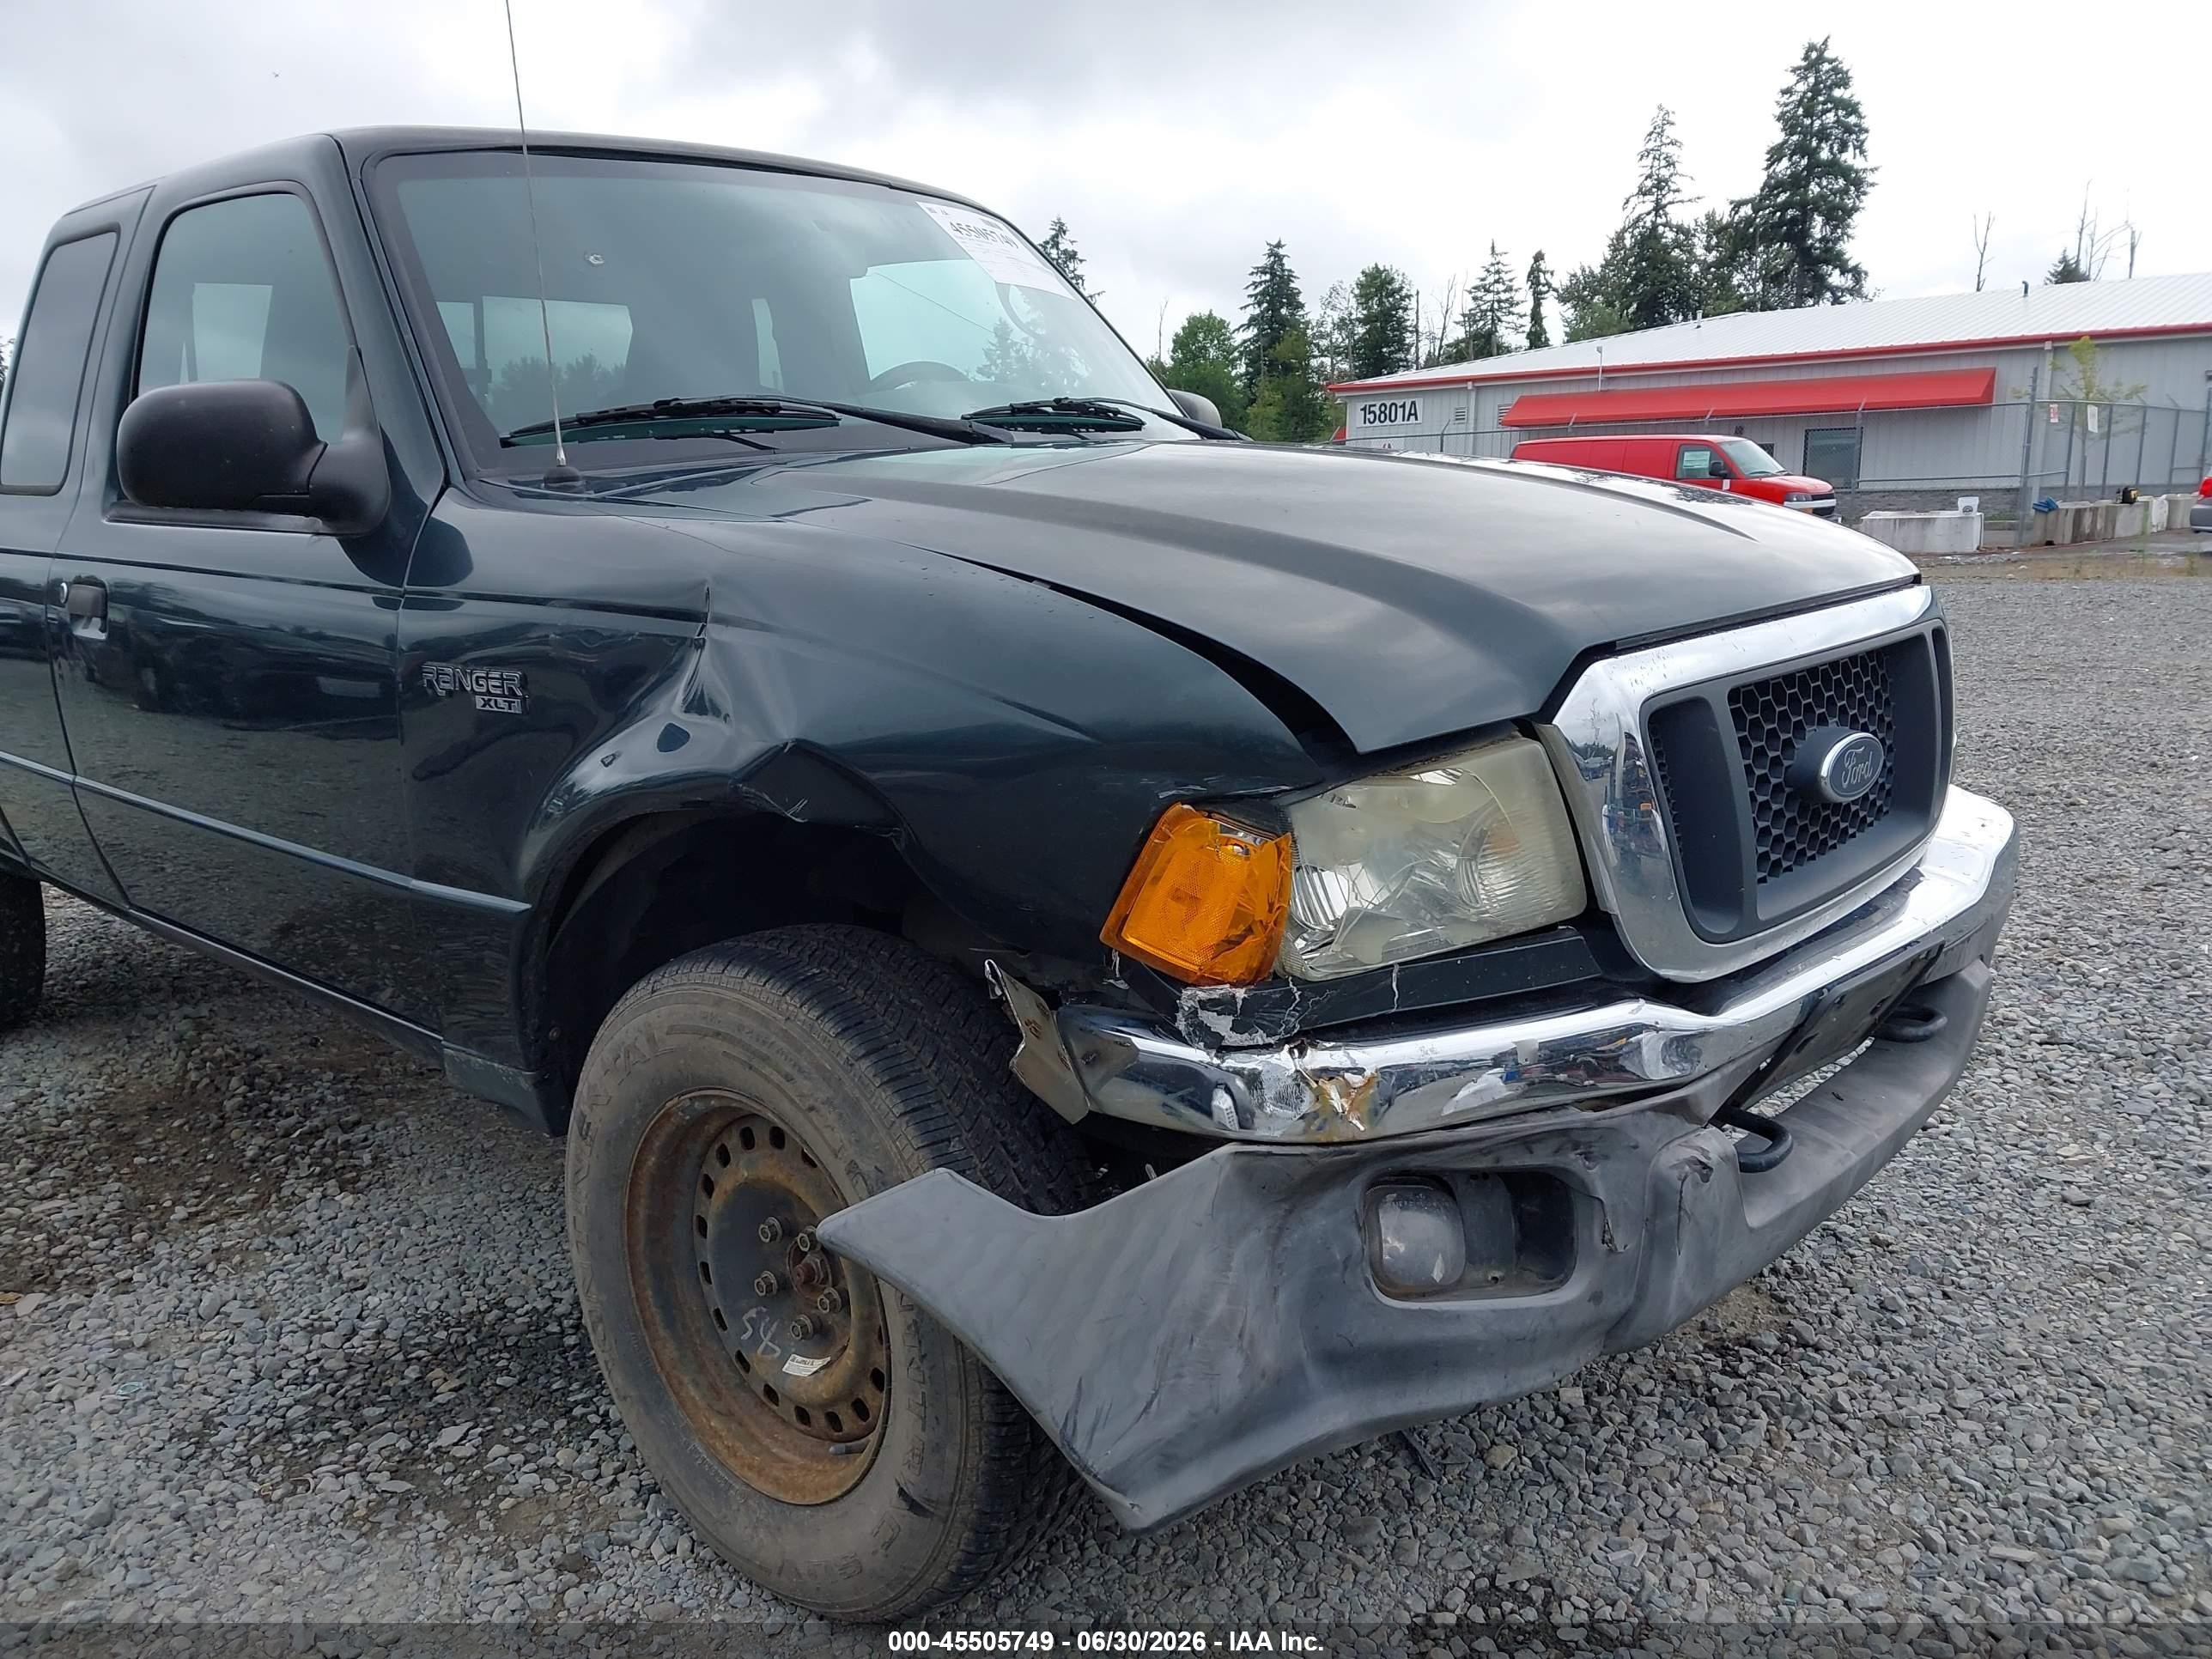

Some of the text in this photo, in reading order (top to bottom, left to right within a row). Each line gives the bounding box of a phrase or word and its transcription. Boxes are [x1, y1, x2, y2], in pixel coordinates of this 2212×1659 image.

[1359, 400, 1419, 425] 15801A
[421, 665, 523, 696] RANGER
[480, 696, 518, 712] XLT
[1841, 745, 1874, 789] Ford
